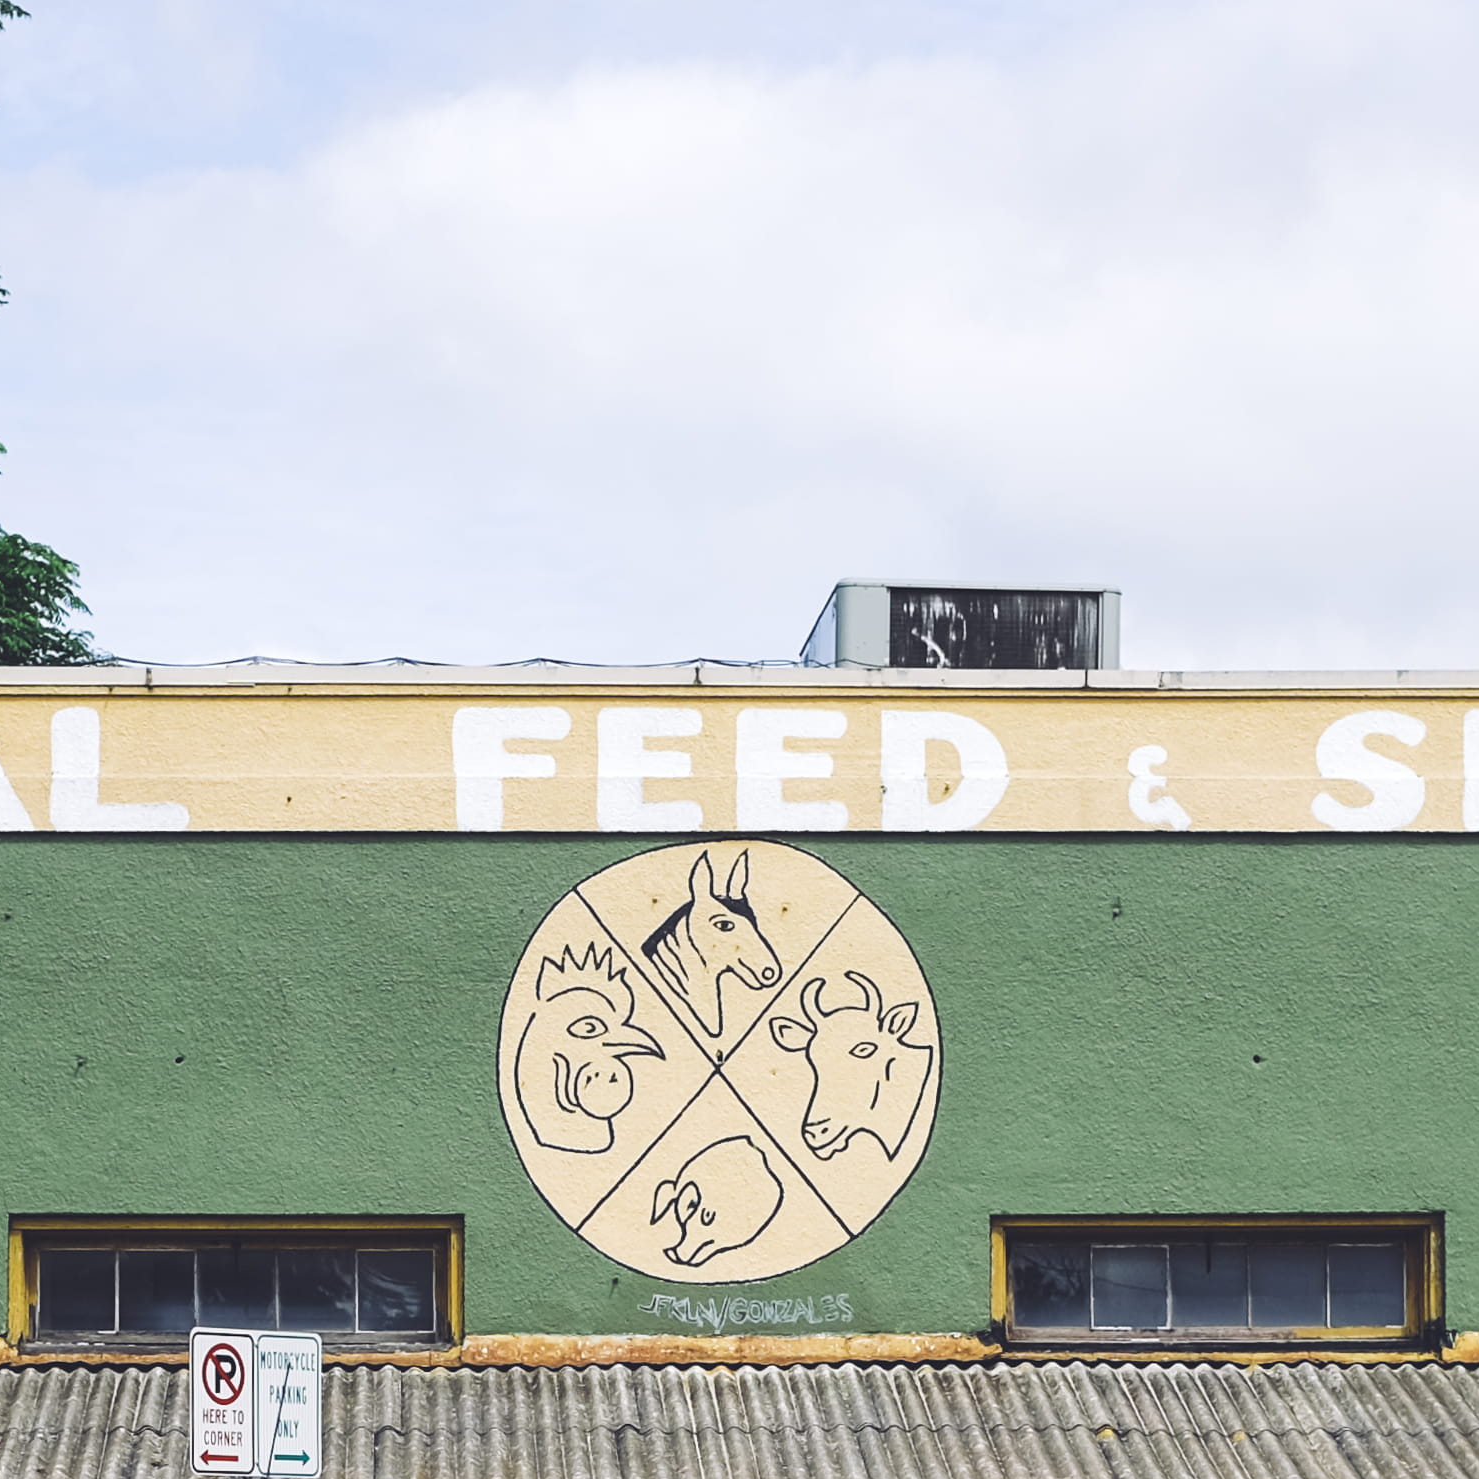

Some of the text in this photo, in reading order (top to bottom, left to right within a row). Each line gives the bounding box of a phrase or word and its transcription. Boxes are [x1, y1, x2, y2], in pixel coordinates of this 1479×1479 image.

[451, 706, 1009, 832] FEED
[1127, 744, 1192, 831] &
[260, 1351, 316, 1372] MOTORCYCLE
[269, 1384, 307, 1405] PARKING
[202, 1408, 245, 1425] HERE TO
[203, 1431, 243, 1447] CORNER
[277, 1419, 300, 1439] ONLY
